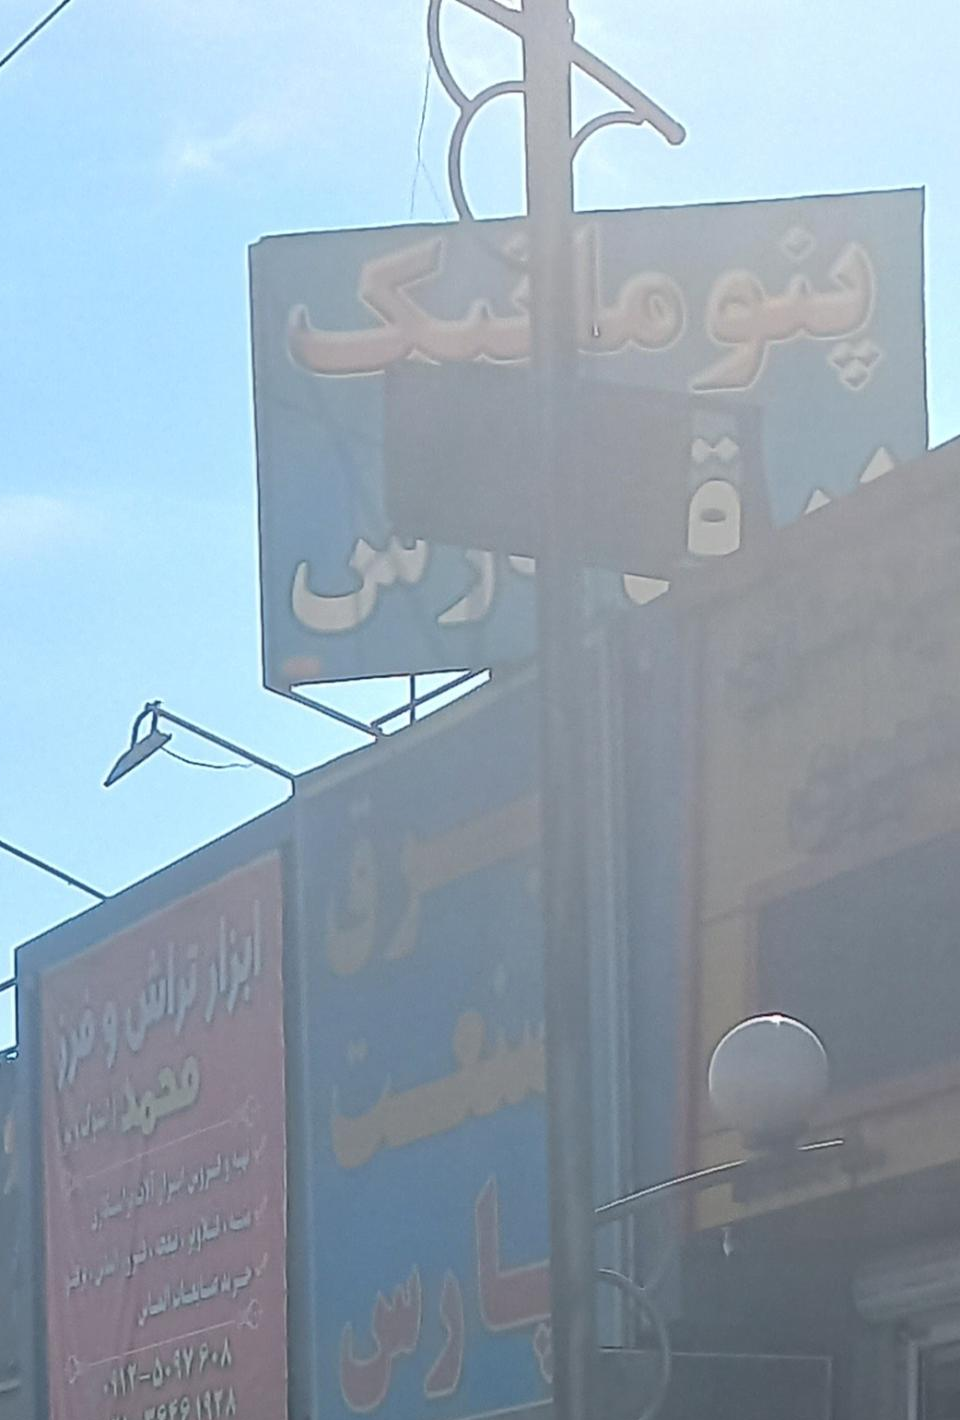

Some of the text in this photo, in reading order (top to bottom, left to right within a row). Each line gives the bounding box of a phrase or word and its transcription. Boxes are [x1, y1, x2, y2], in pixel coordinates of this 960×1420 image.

[126, 942, 199, 1052] تراش
[205, 899, 261, 1024] ابزار
[103, 1000, 118, 1069] و
[121, 1054, 200, 1136] محمد
